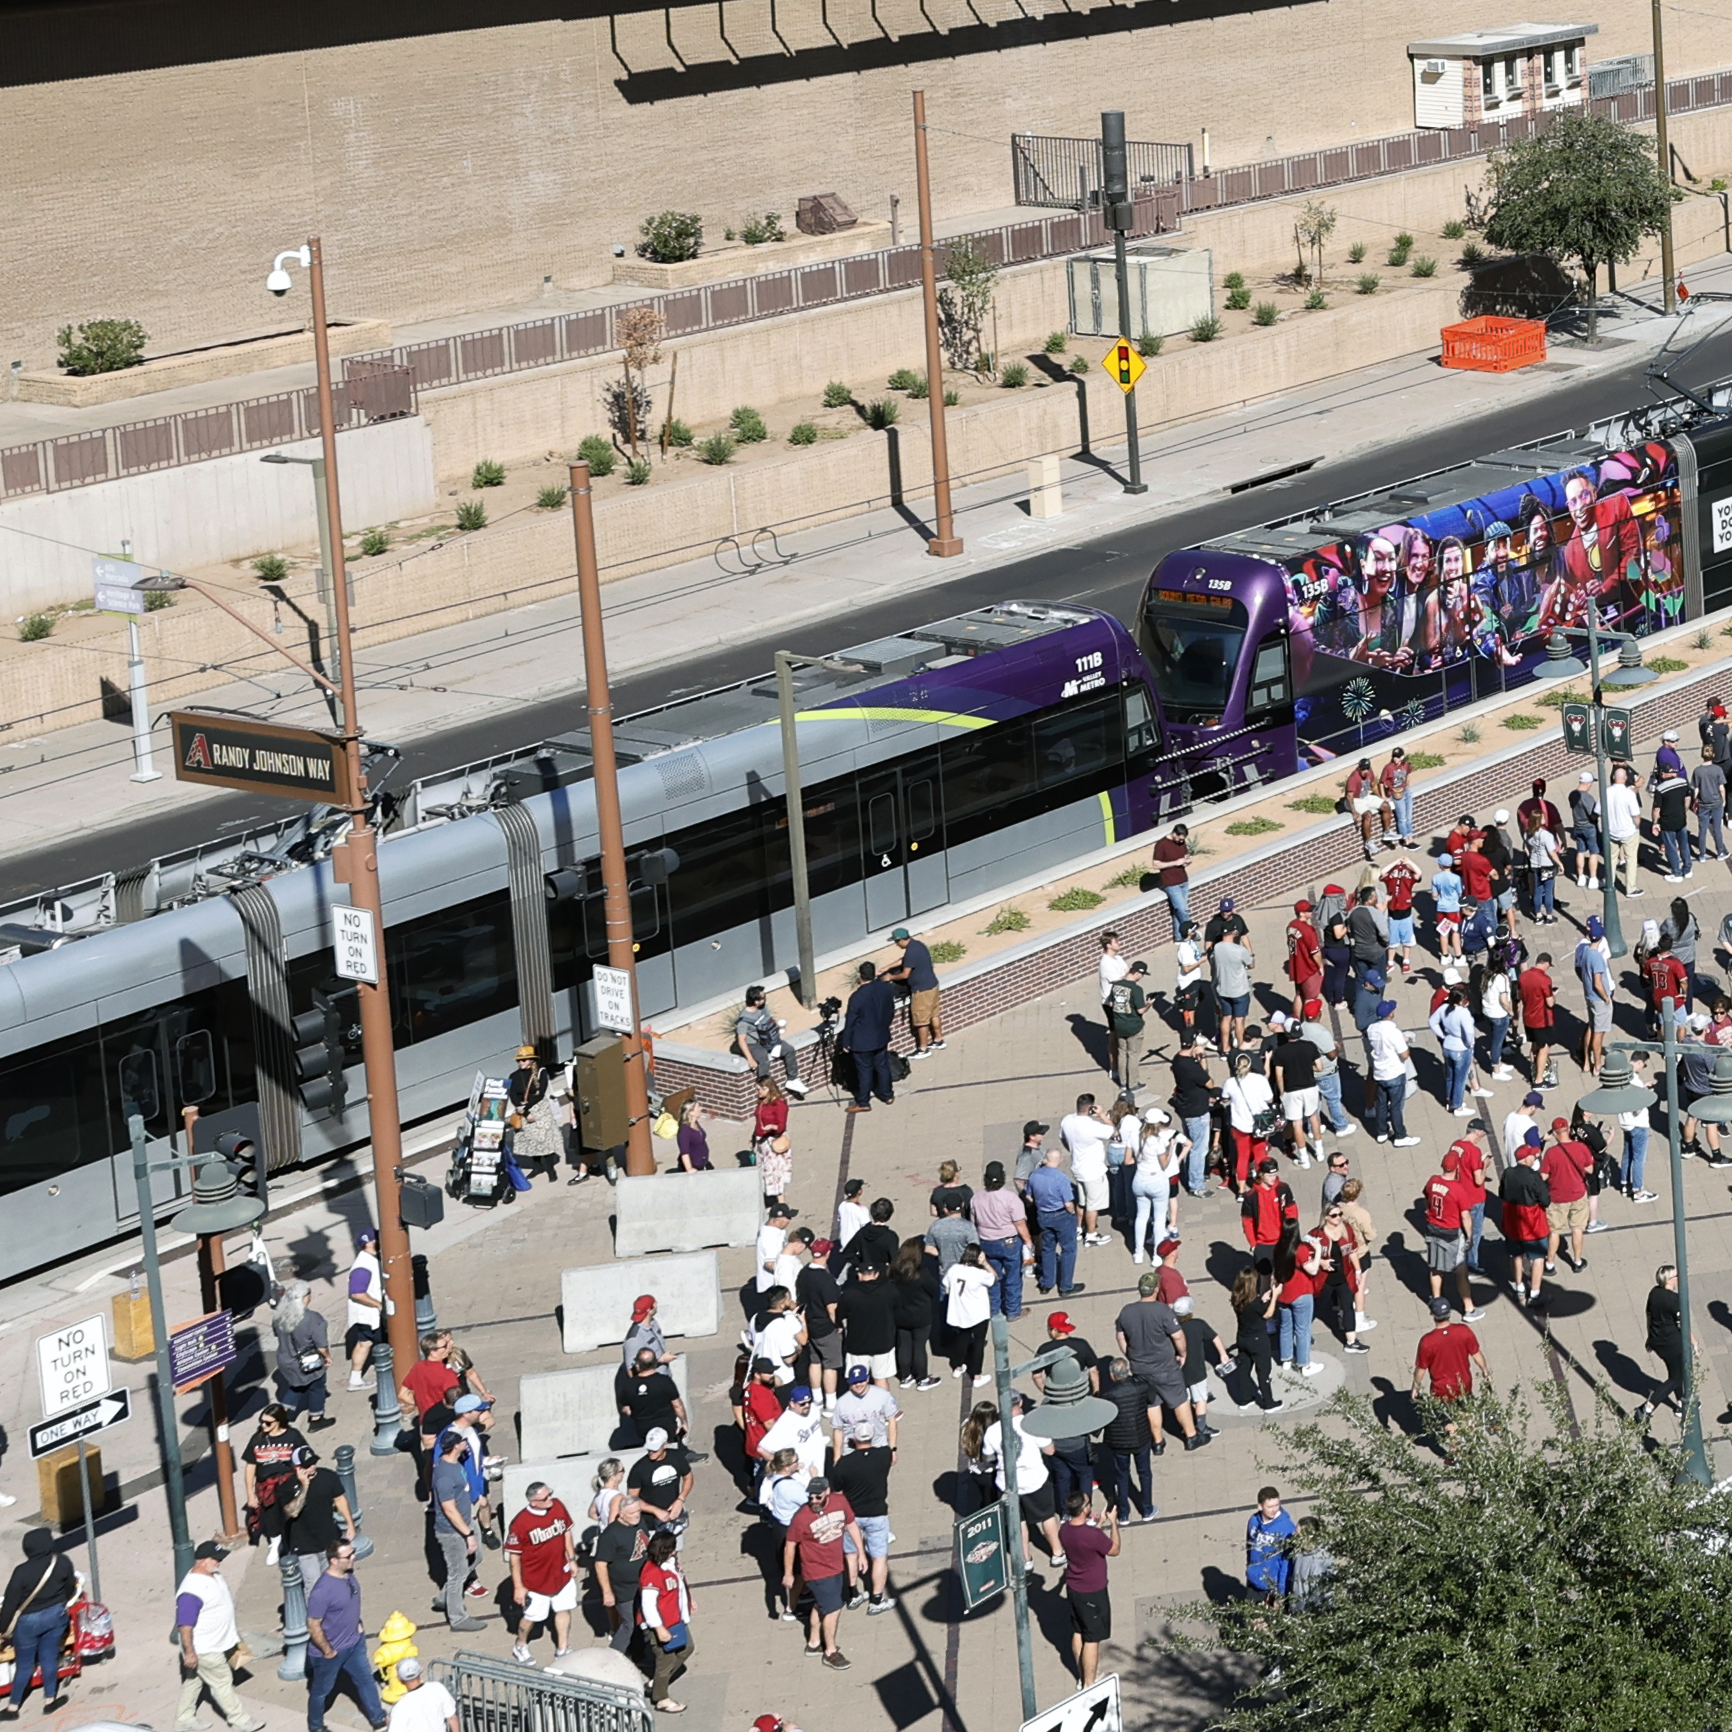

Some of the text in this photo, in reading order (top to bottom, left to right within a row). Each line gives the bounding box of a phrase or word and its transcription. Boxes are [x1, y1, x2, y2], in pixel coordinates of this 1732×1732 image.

[1207, 578, 1233, 591] 135B
[1302, 578, 1330, 599] 135B
[1075, 651, 1103, 673] 111B
[1079, 677, 1106, 693] METRO
[213, 743, 331, 781] RANDY JOHNSON WAY
[344, 912, 365, 928] NO
[340, 929, 368, 945] TURN
[348, 945, 363, 959] ON
[346, 959, 367, 975] RED
[597, 970, 627, 986] DO NOT
[601, 985, 625, 1000] DRIVE
[608, 999, 620, 1011] ON
[600, 1010, 631, 1028] TRACKS
[956, 1278, 966, 1297] 7
[57, 1328, 85, 1352] NO
[50, 1345, 96, 1373] TURN
[63, 1367, 87, 1385] ON
[59, 1379, 94, 1405] RED
[39, 1409, 100, 1444] ONE WAY
[966, 1517, 993, 1539] 2011
